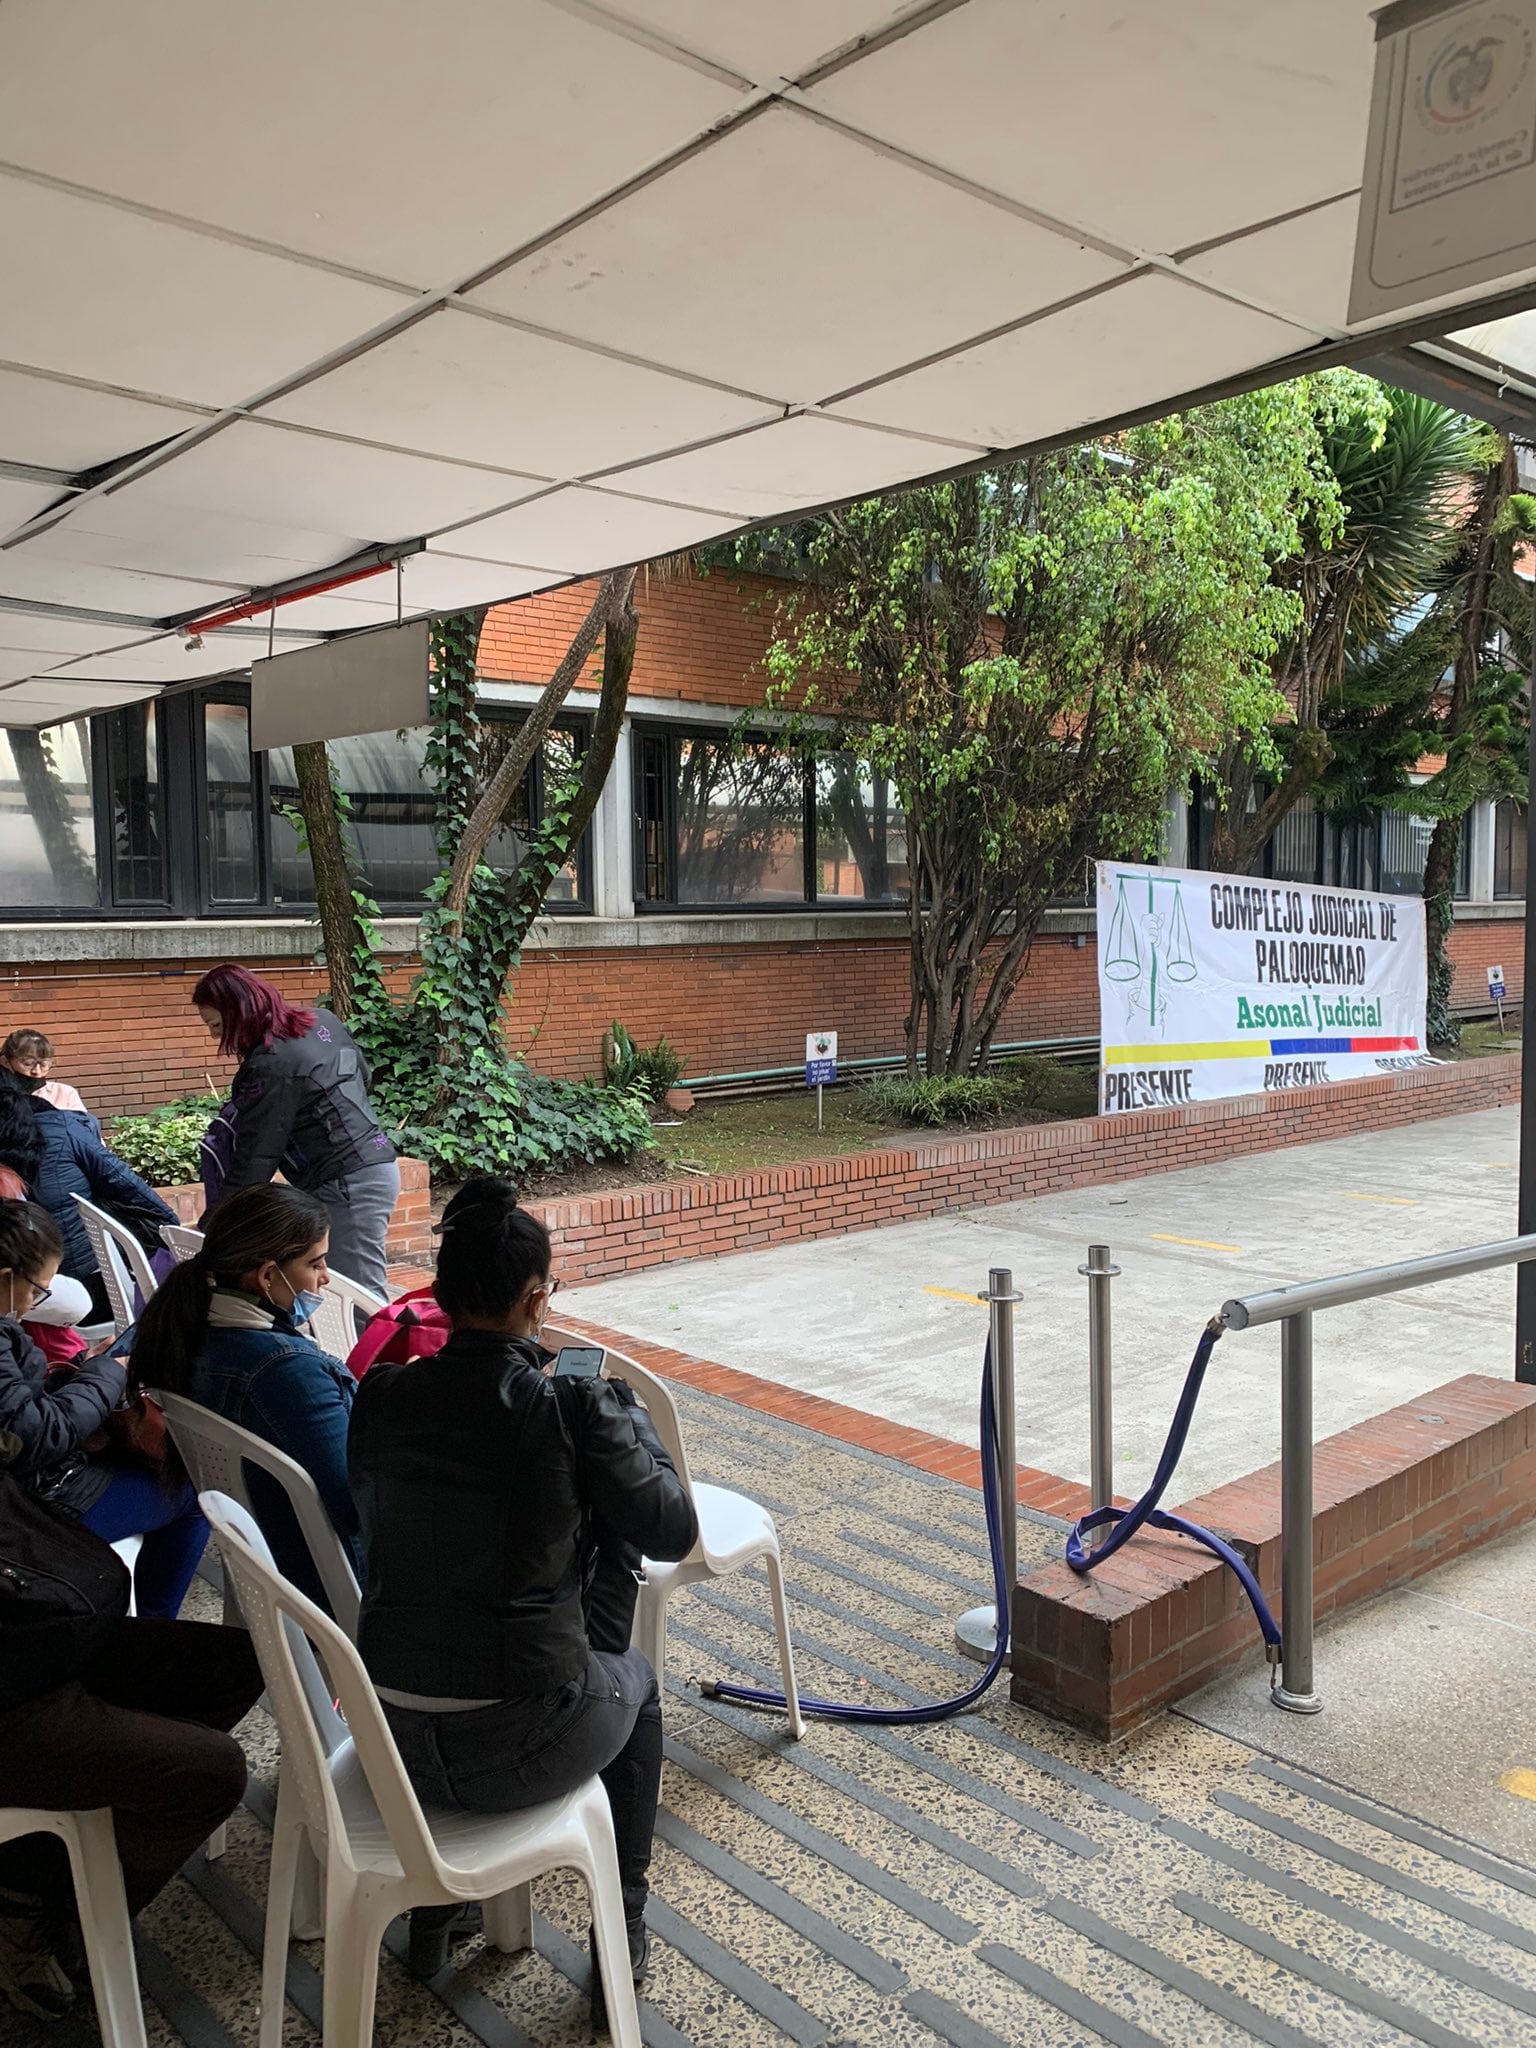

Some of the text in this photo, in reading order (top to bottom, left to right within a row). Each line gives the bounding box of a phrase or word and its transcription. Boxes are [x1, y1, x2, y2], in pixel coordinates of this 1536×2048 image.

[1209, 883, 1398, 943] COMPLEJO JUDICIAL DE
[1255, 939, 1367, 989] PALOQUEMAO
[1236, 995, 1383, 1033] Asonal Judicial
[1105, 1069, 1195, 1112] PRESENTE
[1264, 1061, 1331, 1090] PRESENTE
